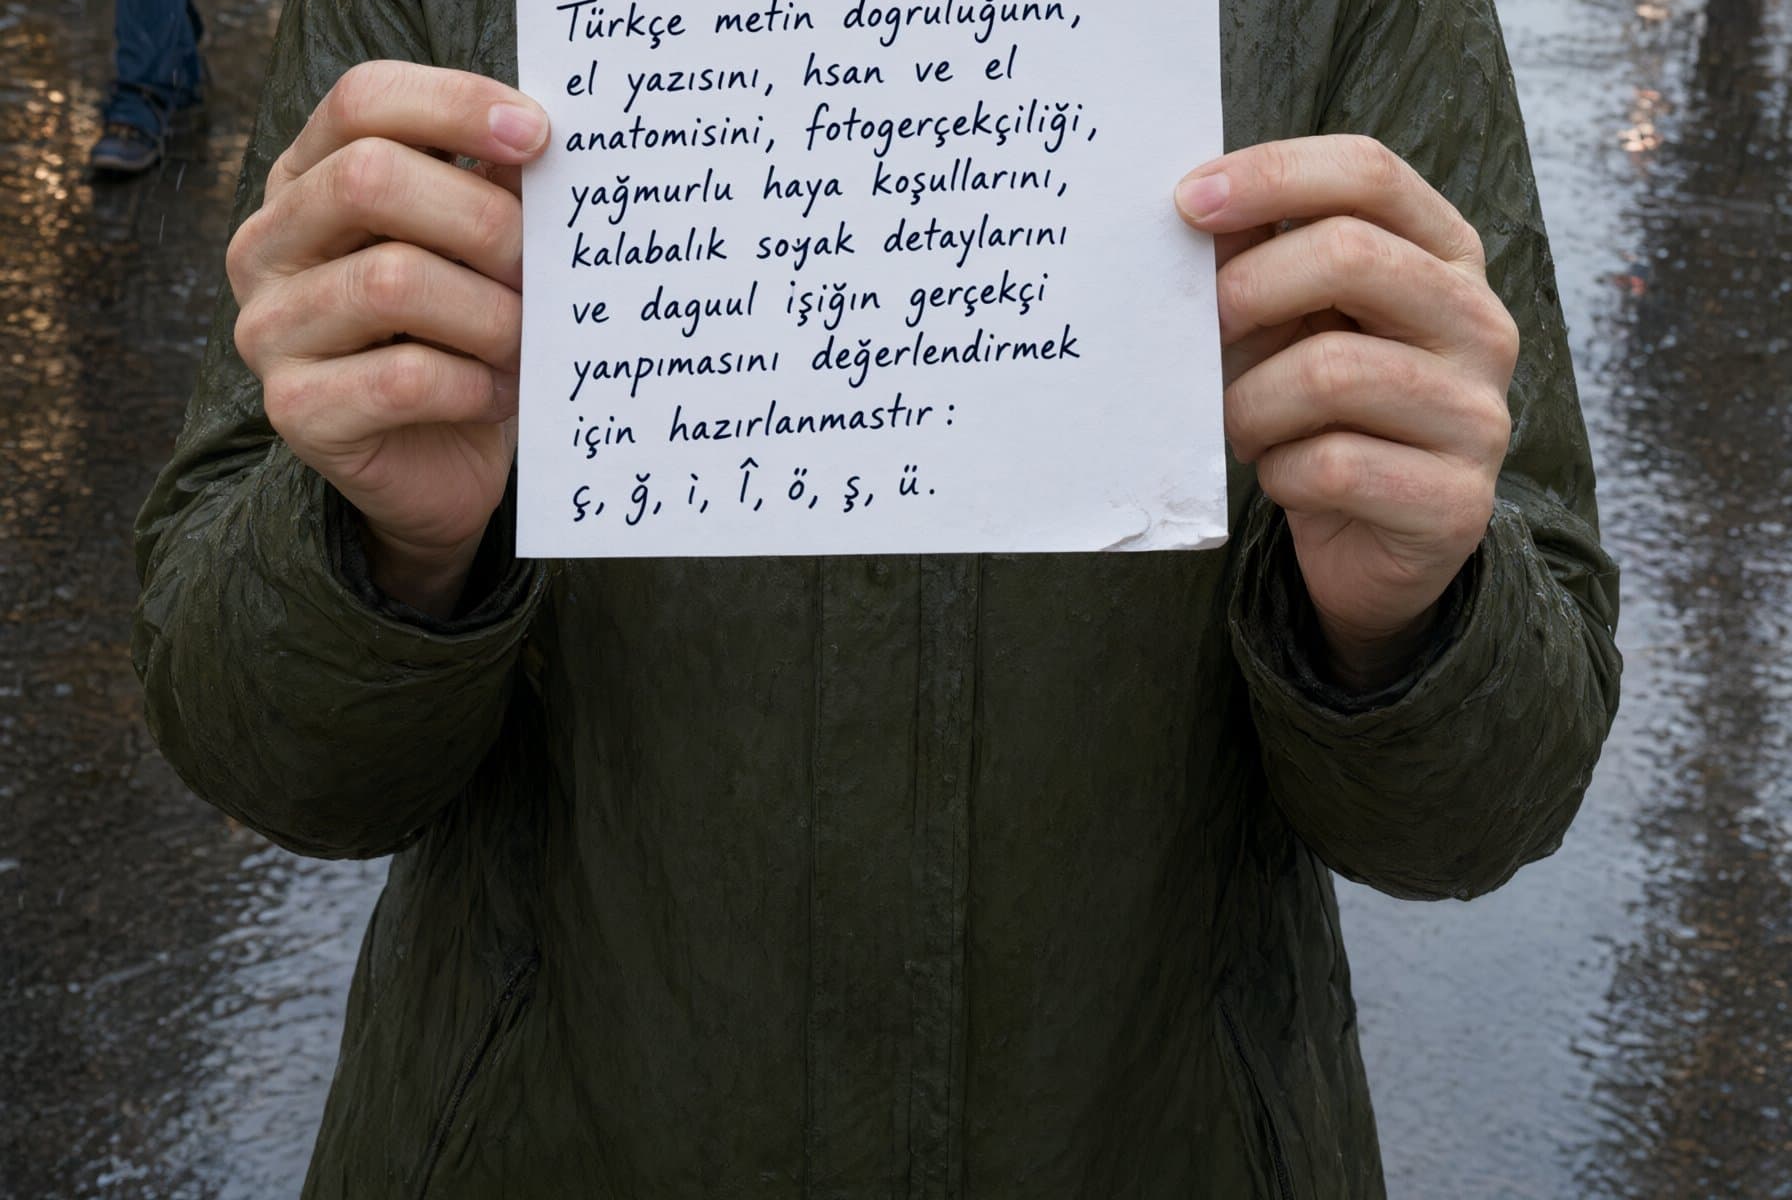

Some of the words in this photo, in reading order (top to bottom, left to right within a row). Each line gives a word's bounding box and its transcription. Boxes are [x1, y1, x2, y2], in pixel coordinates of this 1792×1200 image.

[566, 59, 598, 97] el
[623, 68, 773, 114] yazısını,
[803, 51, 884, 87] hsan
[915, 60, 954, 83] ve
[985, 43, 1018, 81] el
[565, 115, 775, 154] anatomisini,
[805, 98, 1097, 159] fotogerçekçiliği,
[567, 167, 734, 229] yağmurlu
[763, 164, 843, 219] haya
[871, 156, 1067, 206] koşullarını,
[571, 226, 728, 269] kalabalık
[883, 213, 1067, 269] detaylarını
[572, 301, 610, 325] ve
[640, 280, 758, 338] daguul
[905, 269, 1049, 328] gerçekçi
[569, 352, 779, 402] yanpımasını
[811, 323, 1081, 389] değerlendirmek
[573, 415, 636, 460] için
[572, 485, 605, 523] ç,
[625, 472, 662, 526] ğ,
[788, 467, 818, 510] ö,
[843, 475, 874, 513] ş,
[899, 464, 935, 496] ü.
